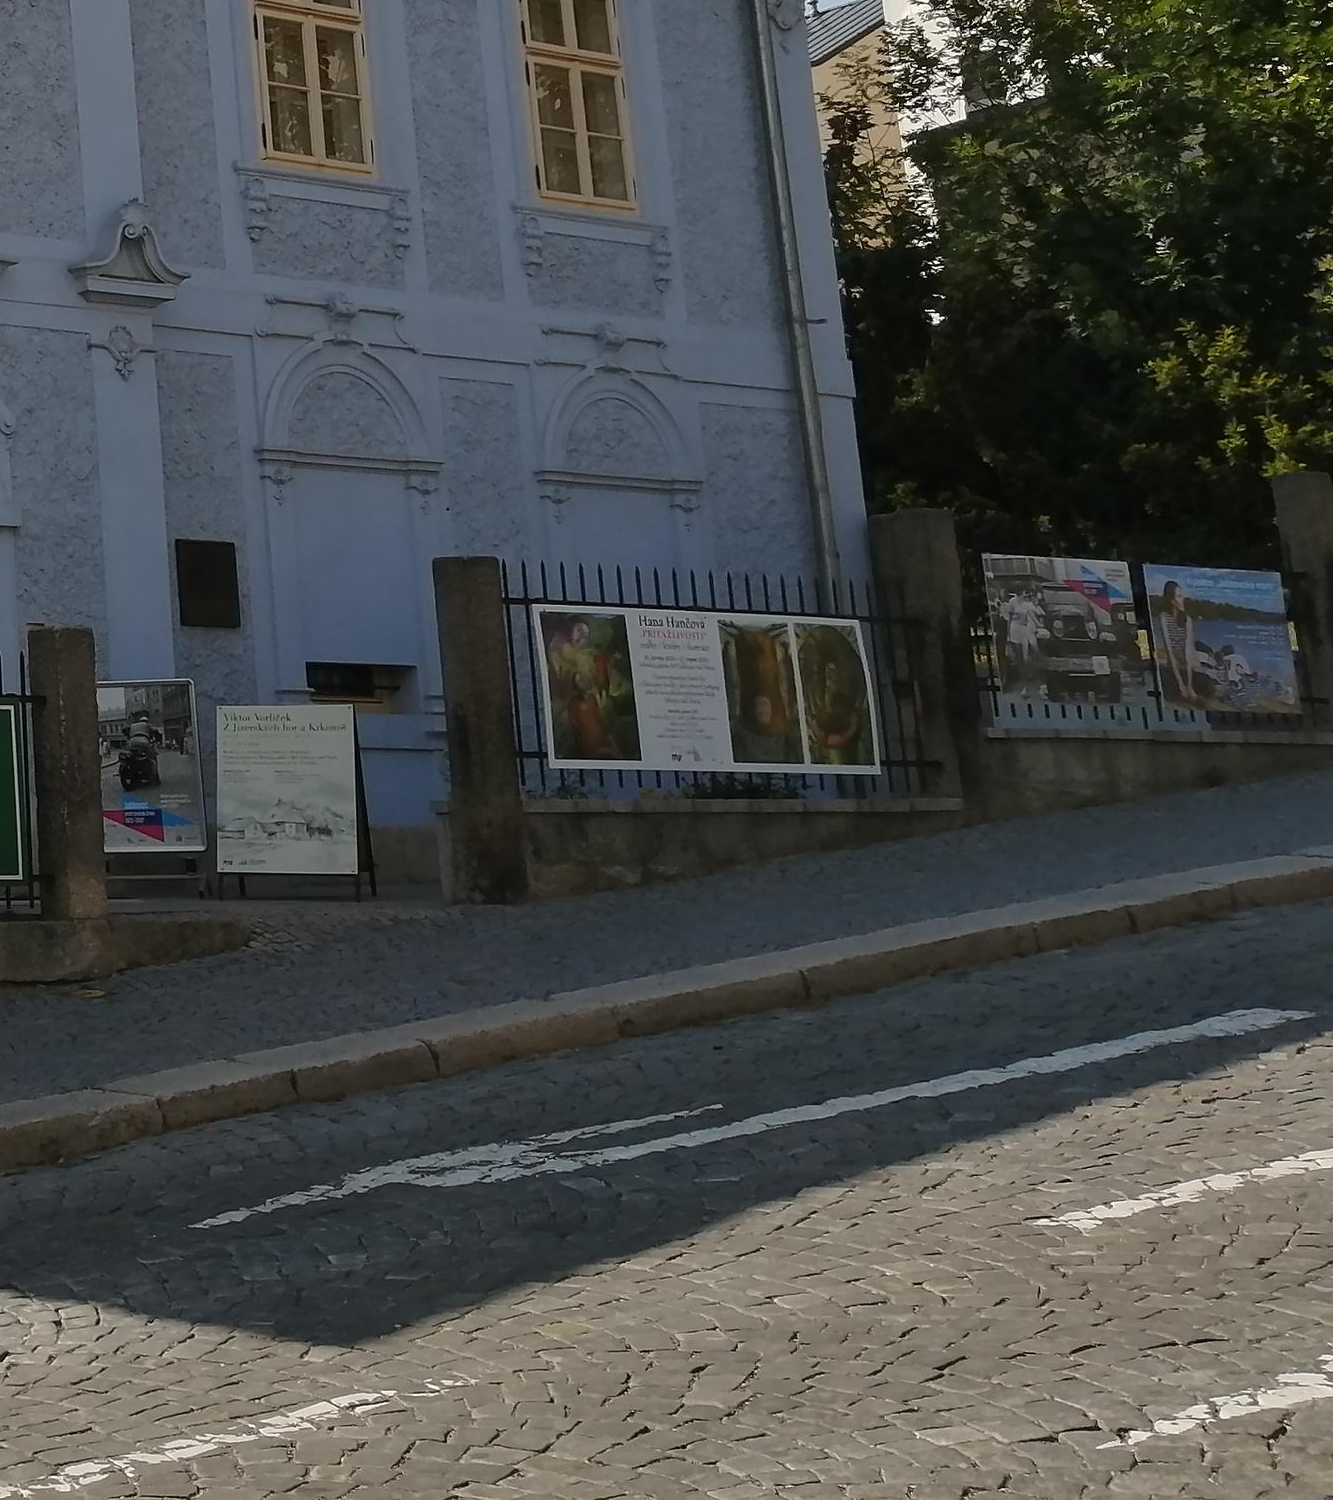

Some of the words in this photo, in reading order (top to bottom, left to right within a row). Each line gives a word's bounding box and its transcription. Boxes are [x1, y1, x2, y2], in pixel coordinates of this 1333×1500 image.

[638, 614, 664, 627] Hana
[666, 616, 707, 629] Hančová
[222, 712, 251, 722] Viktor
[253, 712, 292, 722] Vorlíček
[282, 723, 297, 732] hor
